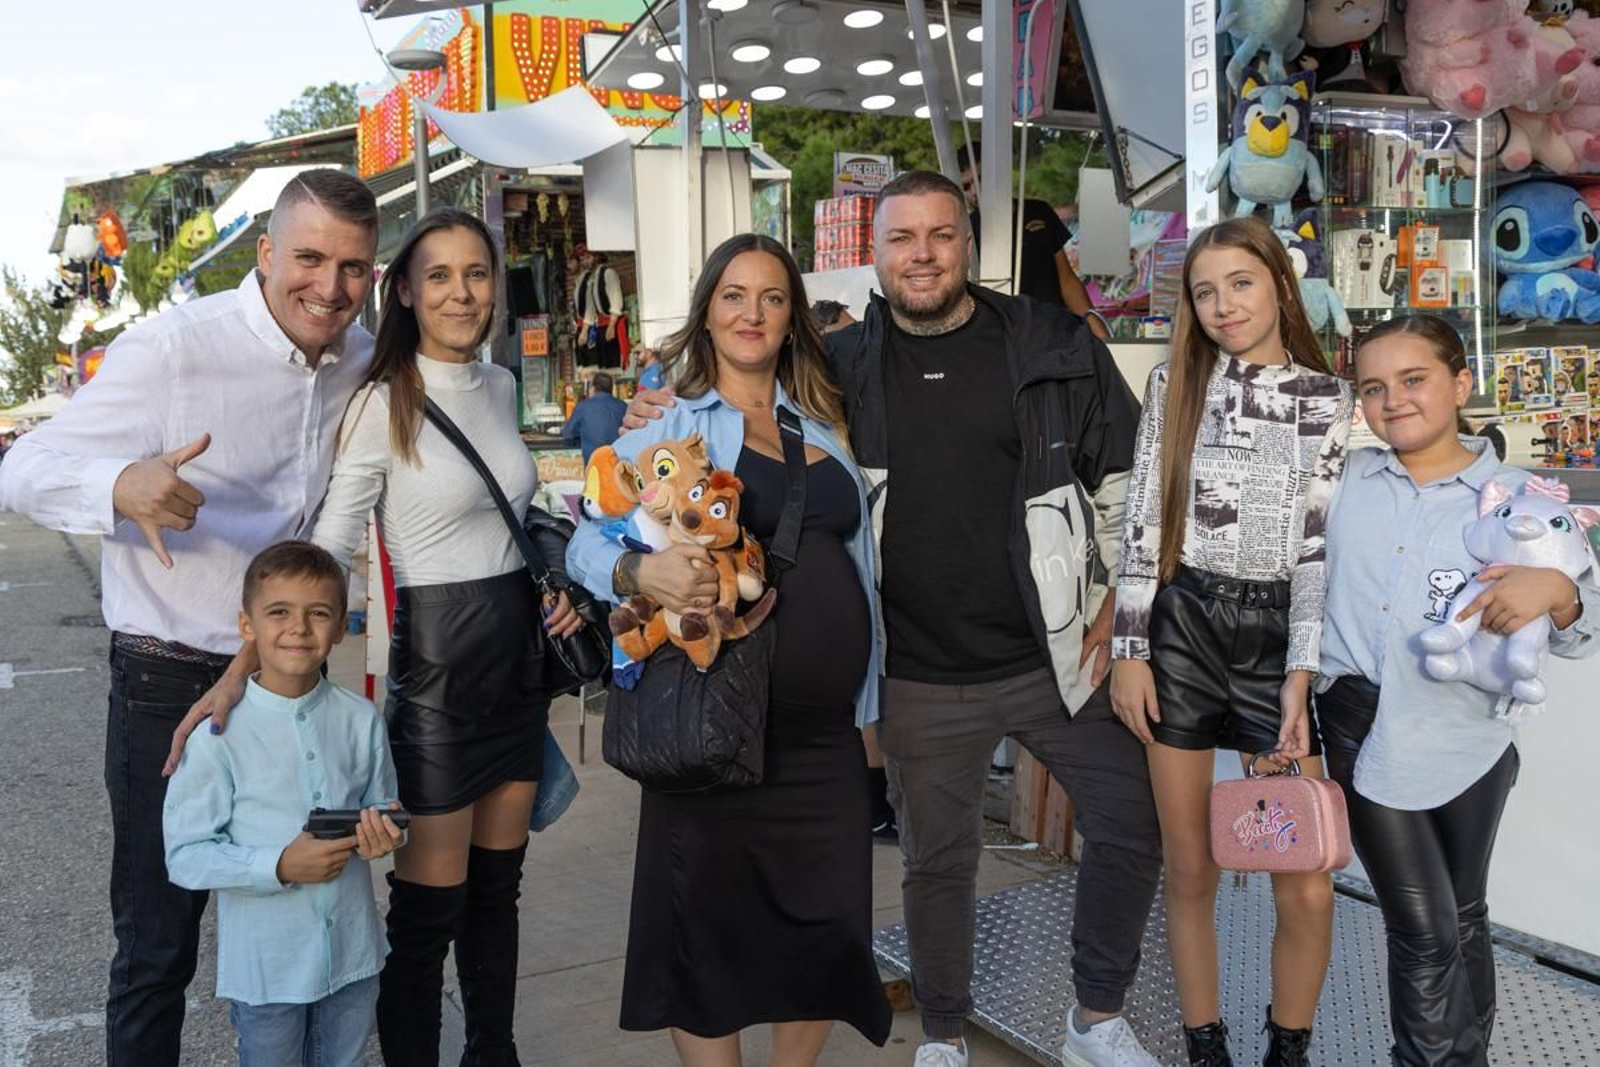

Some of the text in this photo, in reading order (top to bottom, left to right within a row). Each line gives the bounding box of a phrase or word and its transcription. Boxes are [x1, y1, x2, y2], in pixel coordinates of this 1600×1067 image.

[923, 372, 945, 380] HUGO
[1227, 449, 1251, 463] NOW
[1195, 459, 1286, 477] THE ART OF FINDING
[1195, 470, 1234, 481] BALANCE
[1281, 466, 1297, 509] Future
